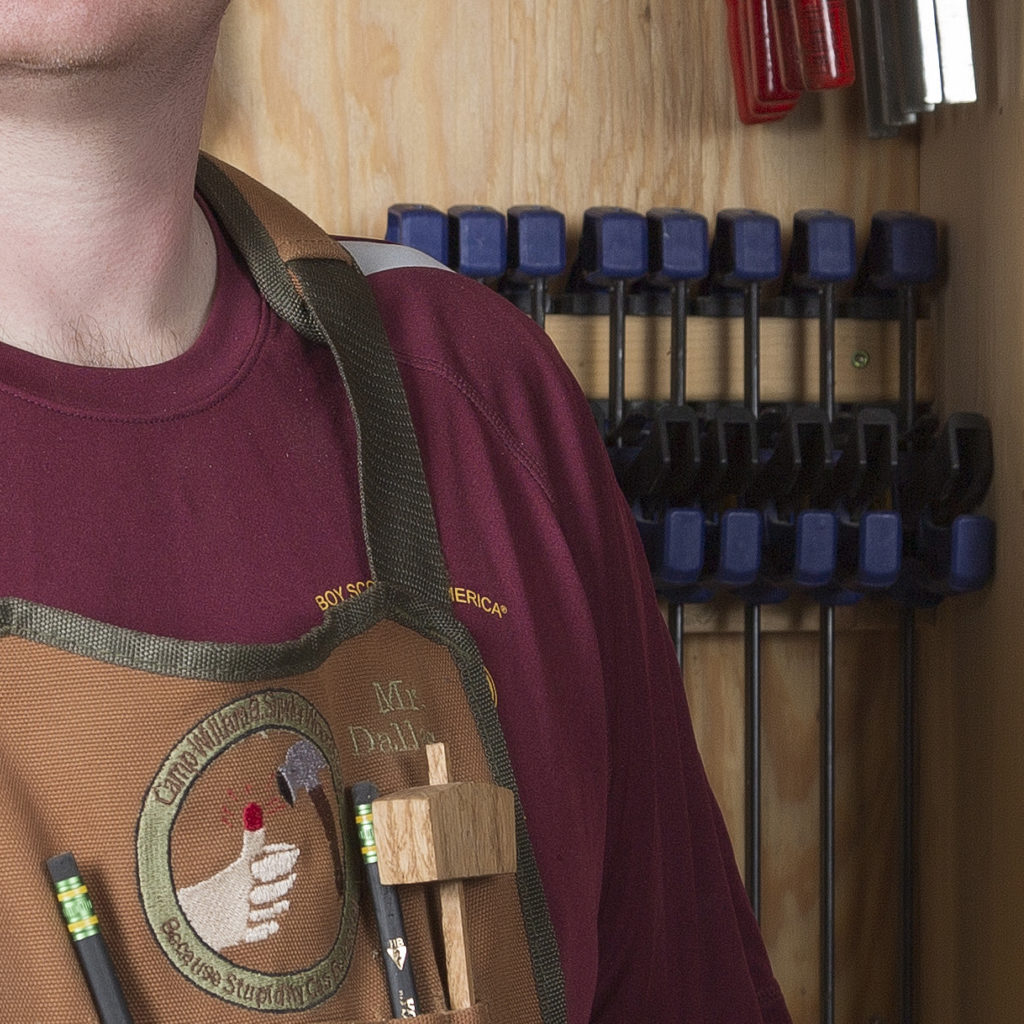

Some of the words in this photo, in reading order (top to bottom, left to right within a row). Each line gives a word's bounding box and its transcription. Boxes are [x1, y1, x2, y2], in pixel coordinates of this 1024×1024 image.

[315, 586, 344, 611] BOY
[152, 750, 201, 806] Camp
[162, 917, 222, 988] Because
